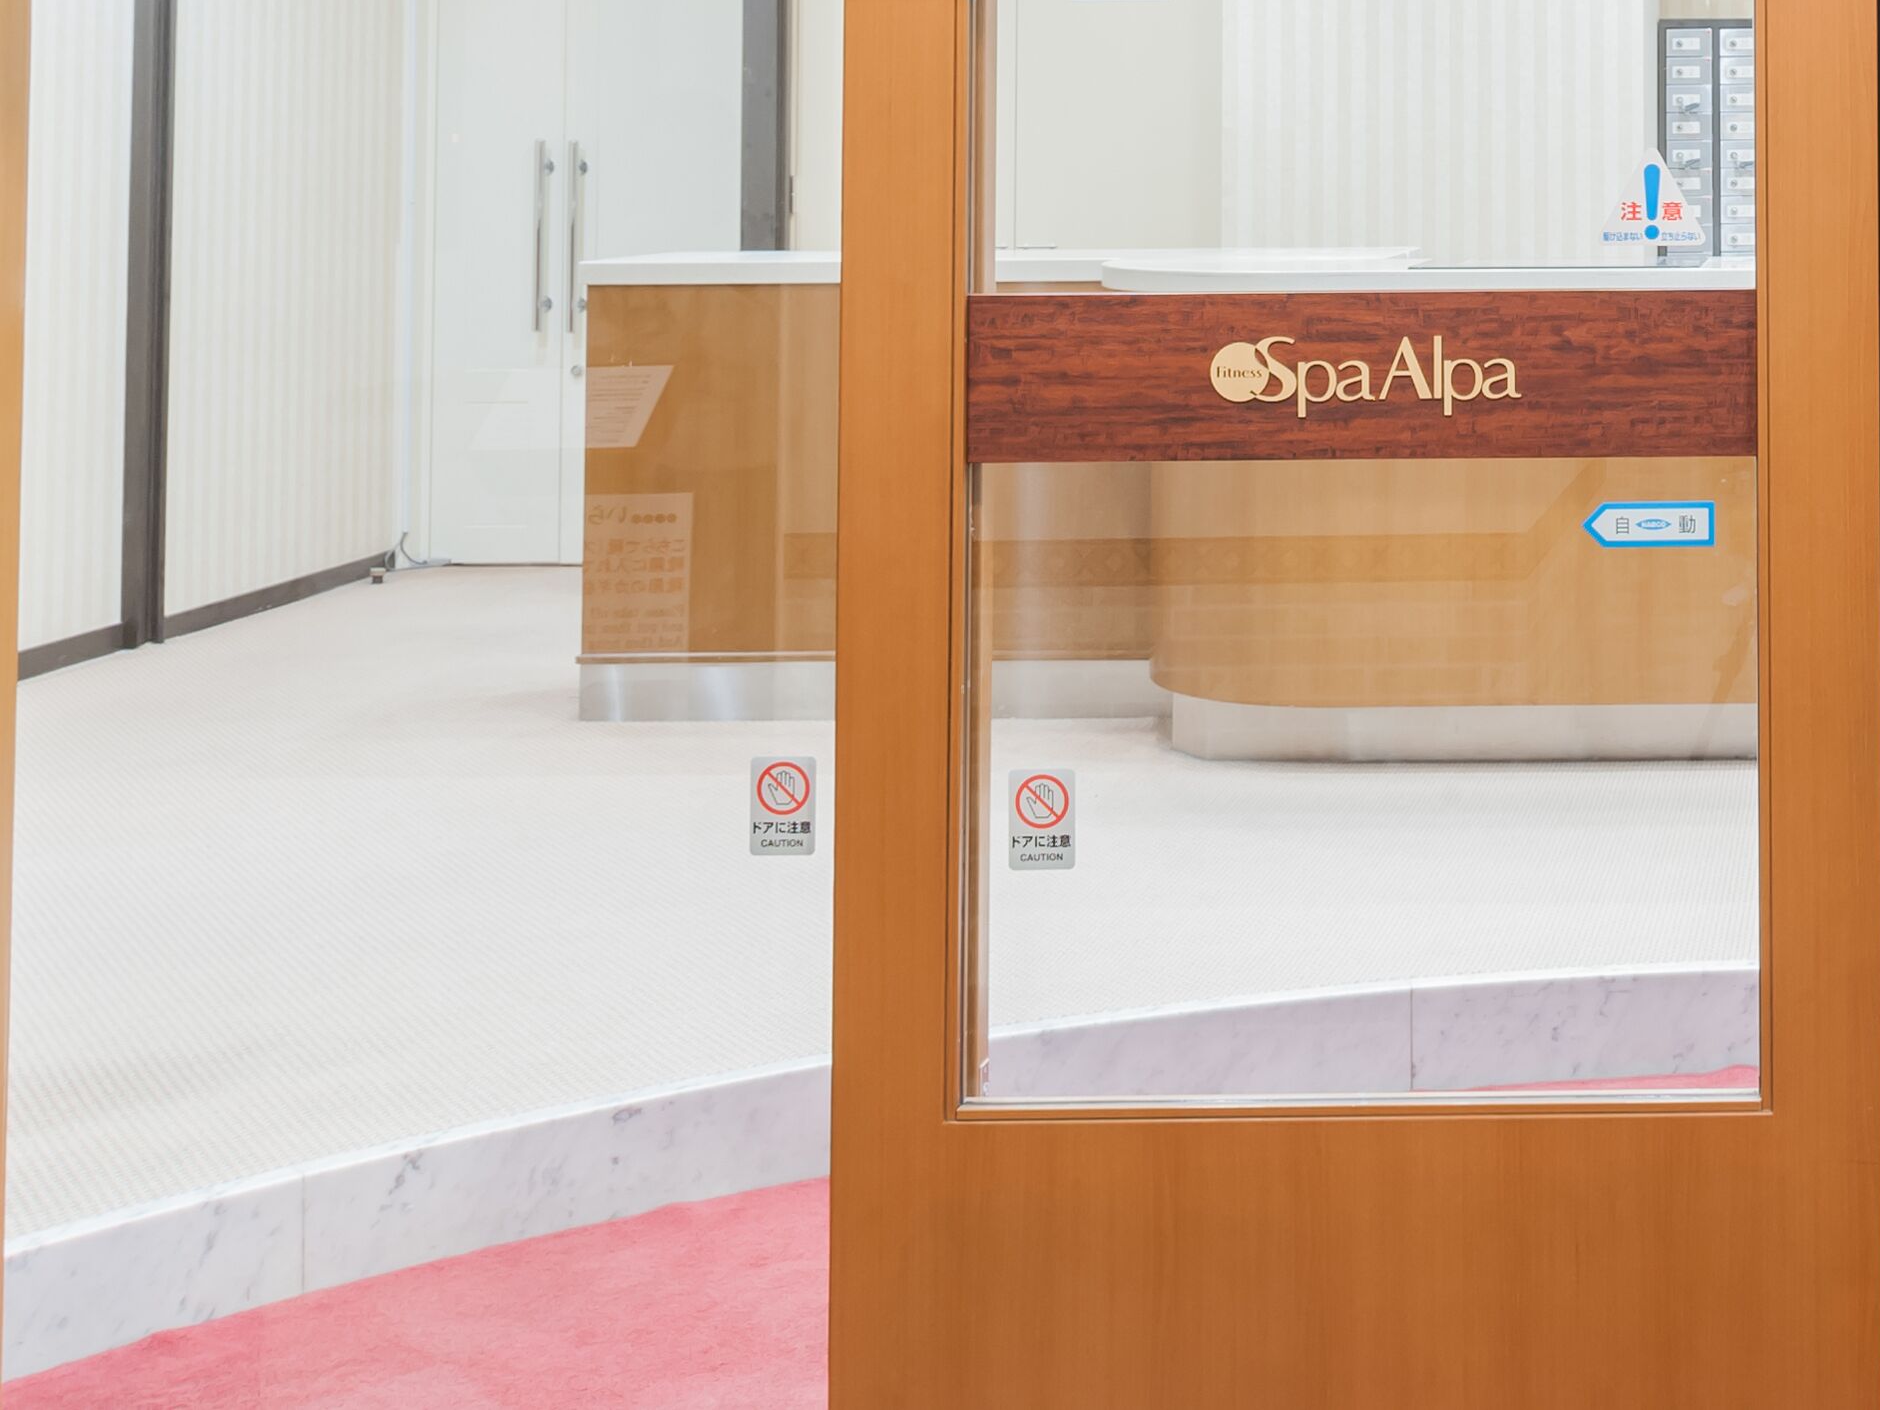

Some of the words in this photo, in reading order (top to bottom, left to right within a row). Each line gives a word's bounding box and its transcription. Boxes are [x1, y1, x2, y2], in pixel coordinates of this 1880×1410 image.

[1216, 366, 1263, 379] Fitness
[1250, 336, 1376, 418] Spa
[1378, 335, 1522, 417] Alpa
[752, 821, 812, 835] ドアに注意
[761, 839, 804, 848] CAUTION
[1012, 834, 1072, 849] ドアに注意
[1020, 852, 1064, 862] CAUTION
